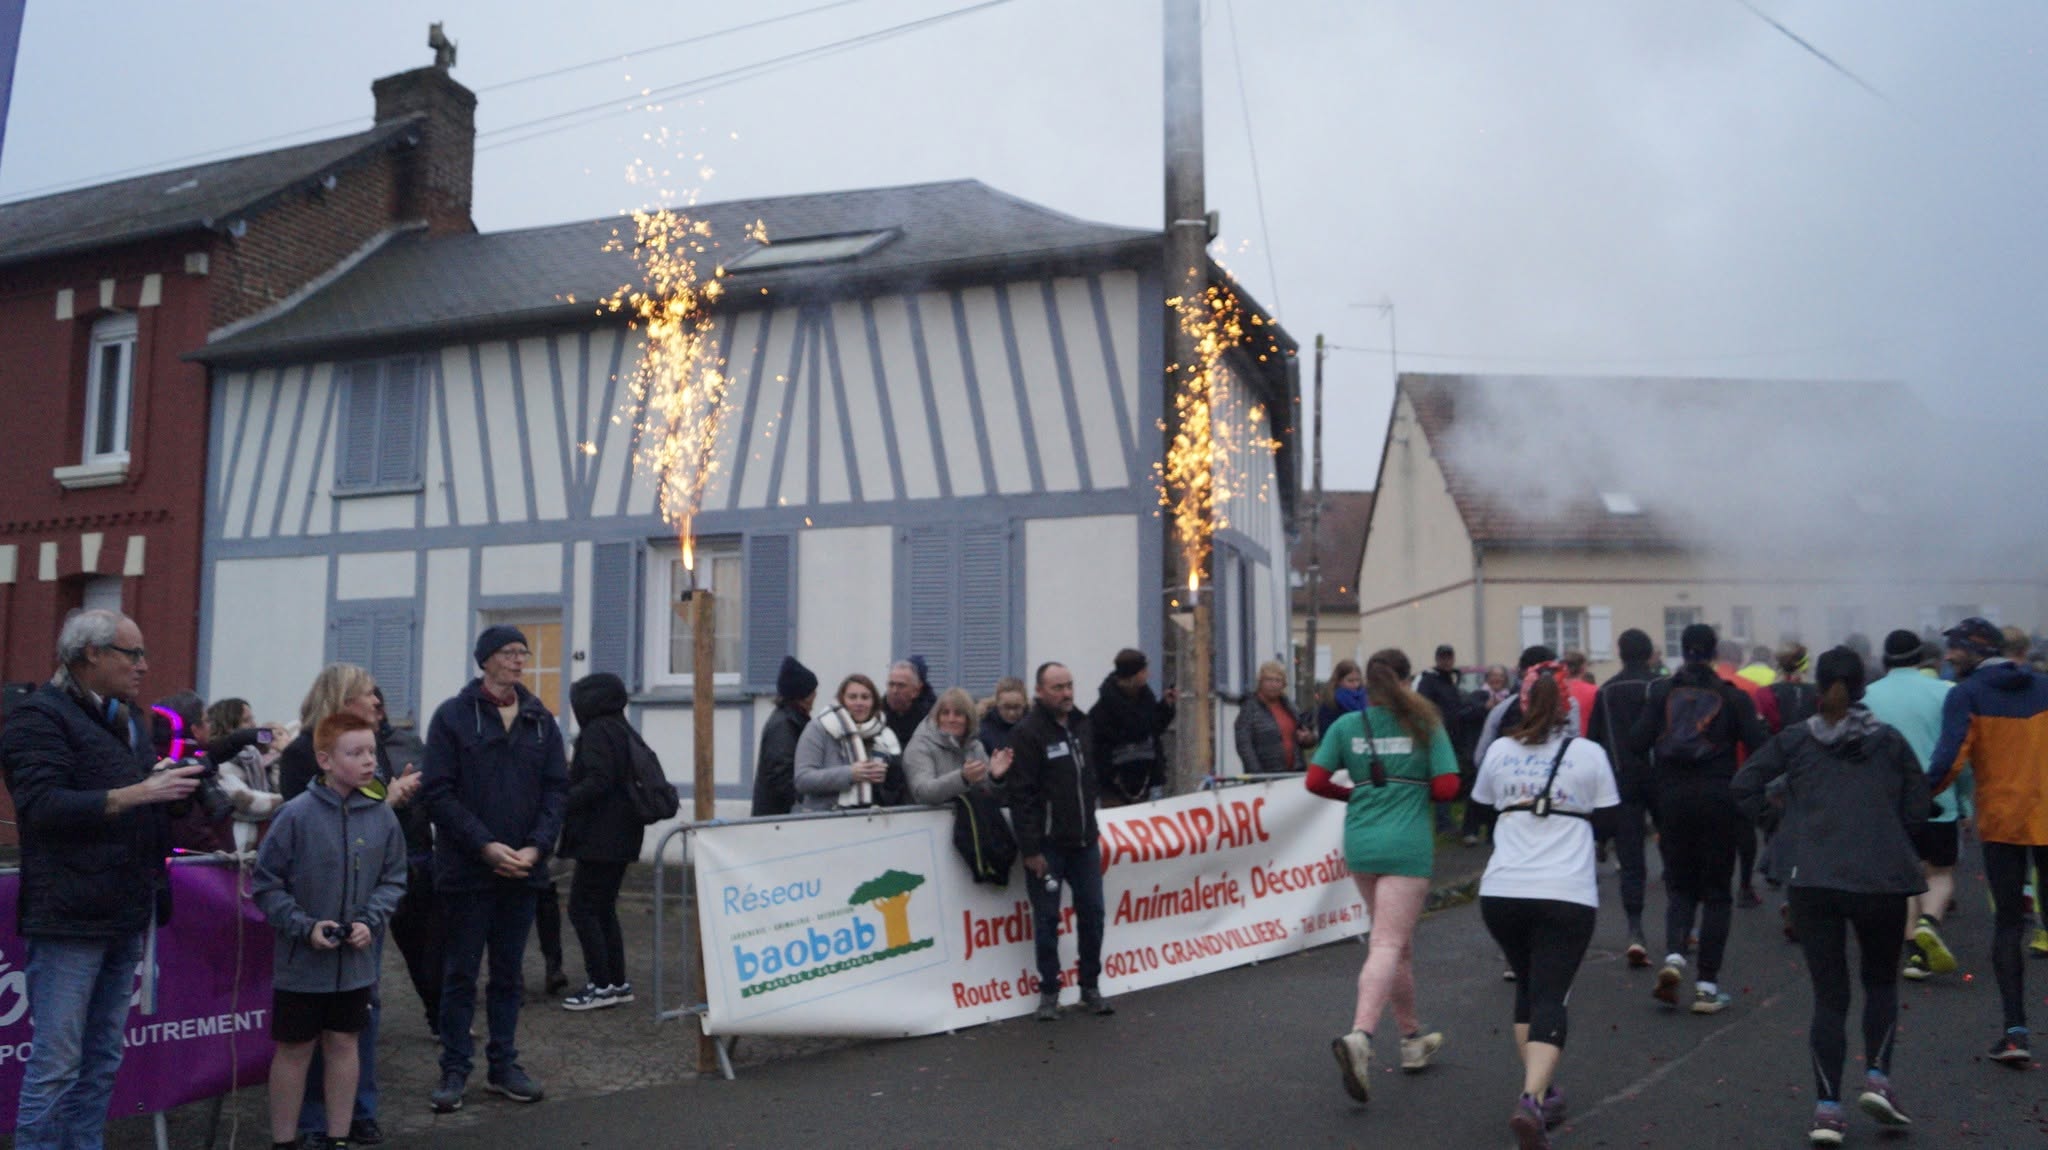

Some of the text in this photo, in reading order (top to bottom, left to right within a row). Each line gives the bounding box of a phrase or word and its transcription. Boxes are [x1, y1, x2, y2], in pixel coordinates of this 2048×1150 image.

[723, 878, 821, 915] Réseau
[1114, 870, 1246, 925] Animalerie,
[733, 916, 876, 982] baobab
[952, 977, 1012, 1008] Route
[1016, 968, 1041, 997] de
[1105, 946, 1158, 978] 60210
[1161, 918, 1288, 965] GRANDVILLIERS
